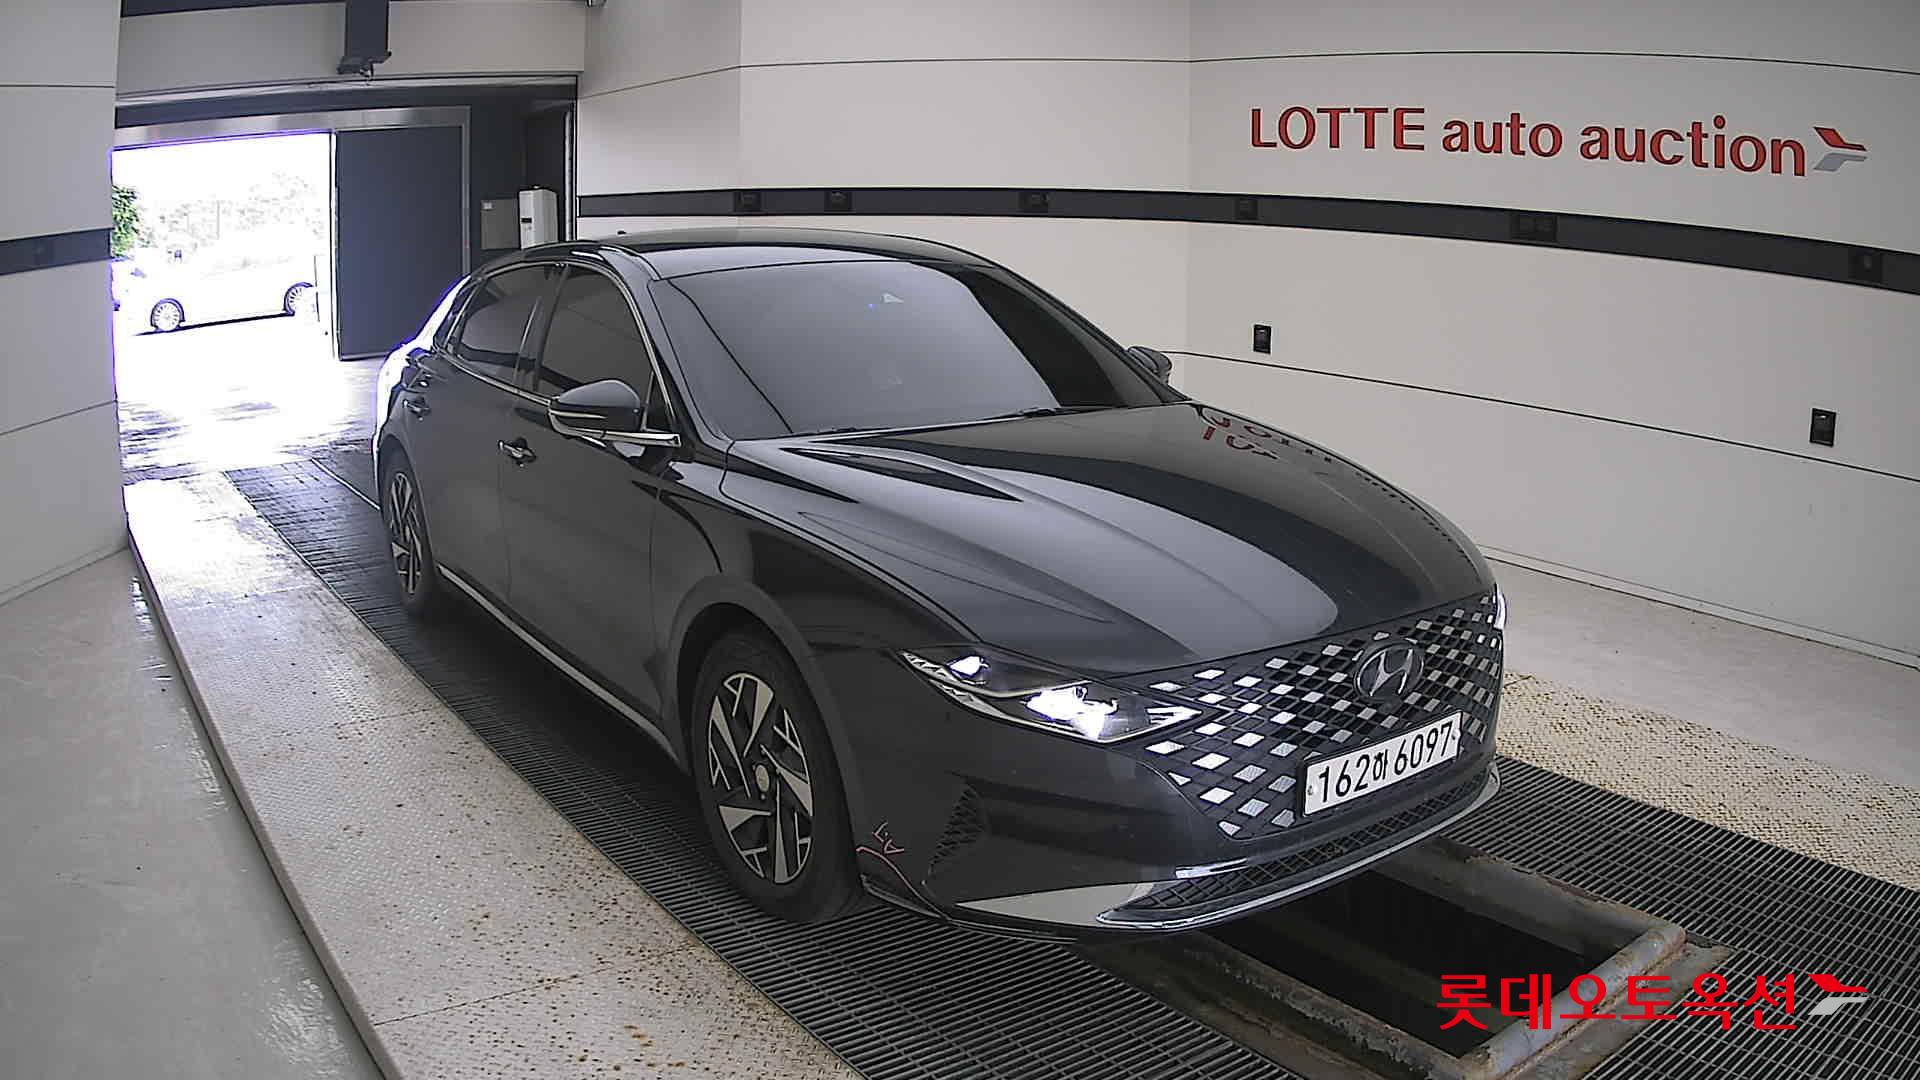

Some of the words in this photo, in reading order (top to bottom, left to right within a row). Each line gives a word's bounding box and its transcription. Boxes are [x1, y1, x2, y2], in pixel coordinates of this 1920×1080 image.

[1250, 106, 1425, 151] LOTTE
[1442, 111, 1563, 157] auto
[1580, 115, 1806, 177] auction
